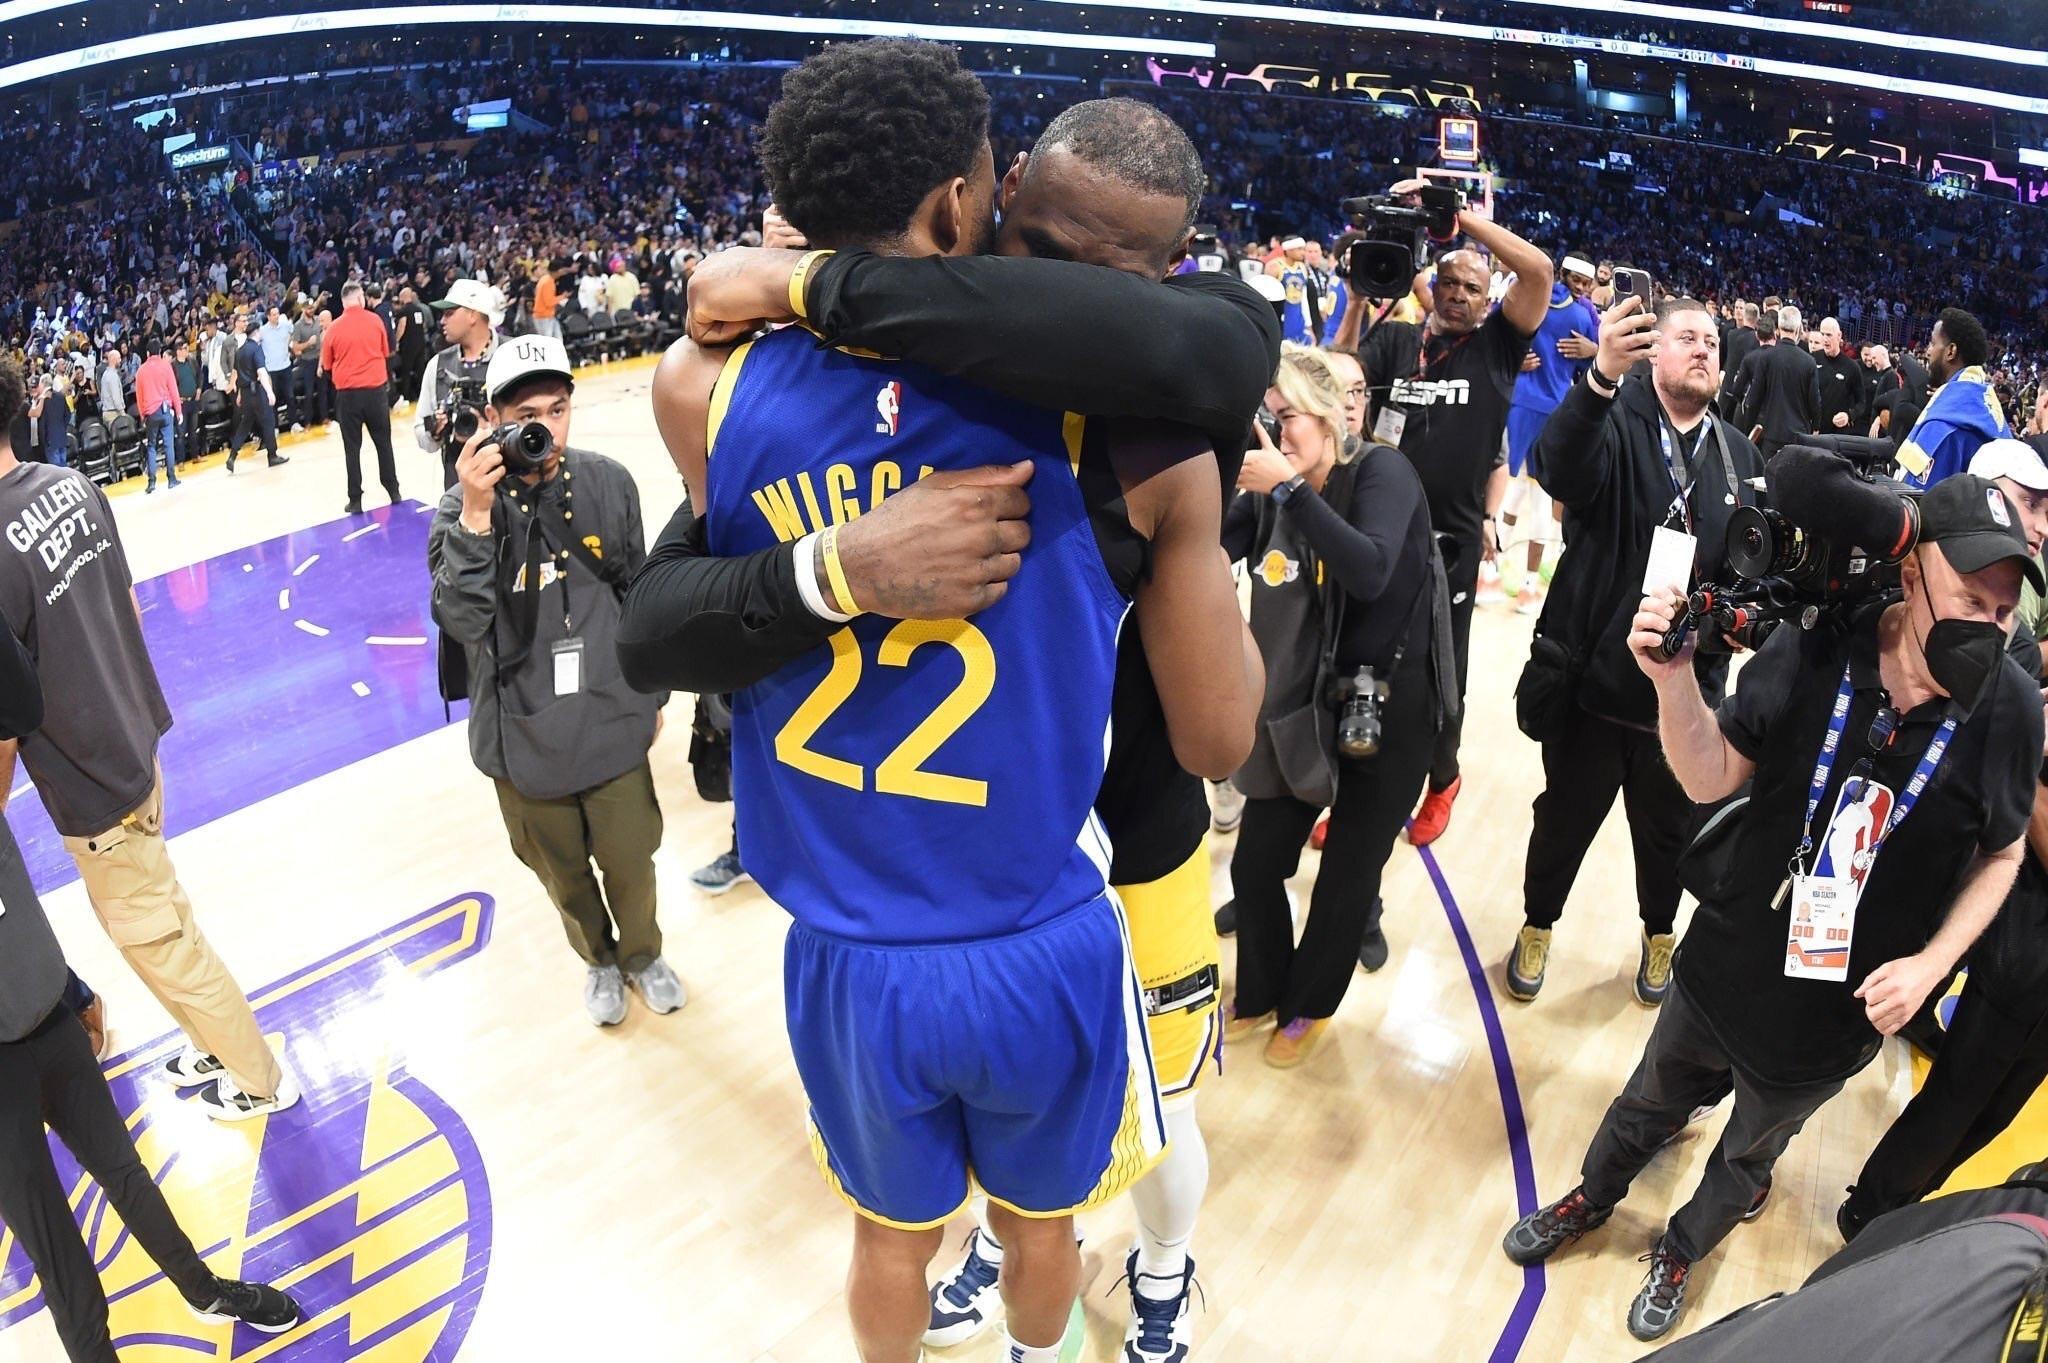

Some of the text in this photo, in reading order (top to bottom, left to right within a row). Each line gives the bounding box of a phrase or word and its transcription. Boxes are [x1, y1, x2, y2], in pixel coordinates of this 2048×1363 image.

[172, 147, 226, 167] Spectrum
[1390, 378, 1470, 406] ESPN
[6, 475, 89, 553] GALLERY
[38, 507, 98, 573] DEPT.
[775, 617, 997, 808] 22
[1834, 693, 1851, 713] NBA
[1824, 729, 1840, 748] NBA
[1925, 743, 1944, 765] NBA
[1814, 764, 1830, 783] NBA
[1906, 776, 1926, 797] NBA
